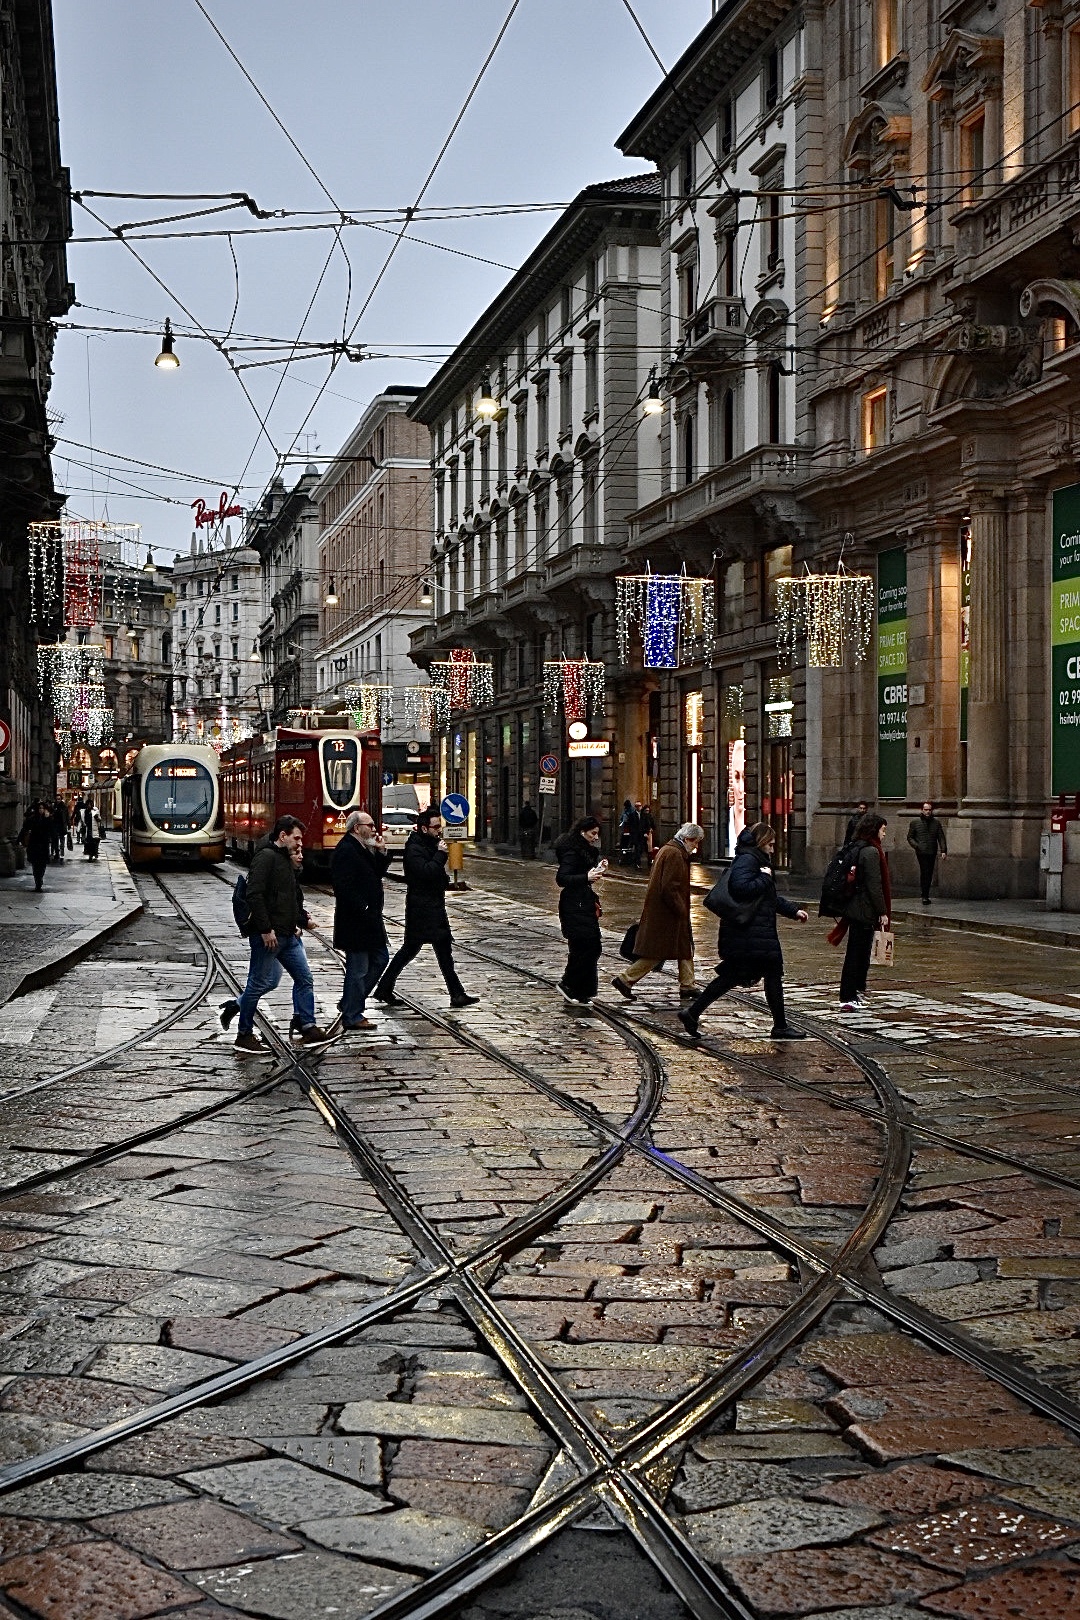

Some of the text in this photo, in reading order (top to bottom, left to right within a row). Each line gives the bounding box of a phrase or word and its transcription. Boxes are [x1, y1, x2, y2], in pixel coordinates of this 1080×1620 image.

[1060, 555, 1073, 568] your
[879, 586, 907, 600] Coming soo
[1060, 591, 1080, 609] PRIM
[1060, 615, 1080, 633] SPAC
[880, 631, 907, 648] PRIME RET
[879, 652, 896, 667] SPACE
[896, 652, 905, 664] TO
[883, 684, 908, 705] CBRE
[1059, 689, 1080, 706] 02 99
[879, 713, 886, 725] 02
[886, 712, 900, 724] 9974
[1059, 712, 1080, 726] hsitaly
[334, 742, 345, 751] 12
